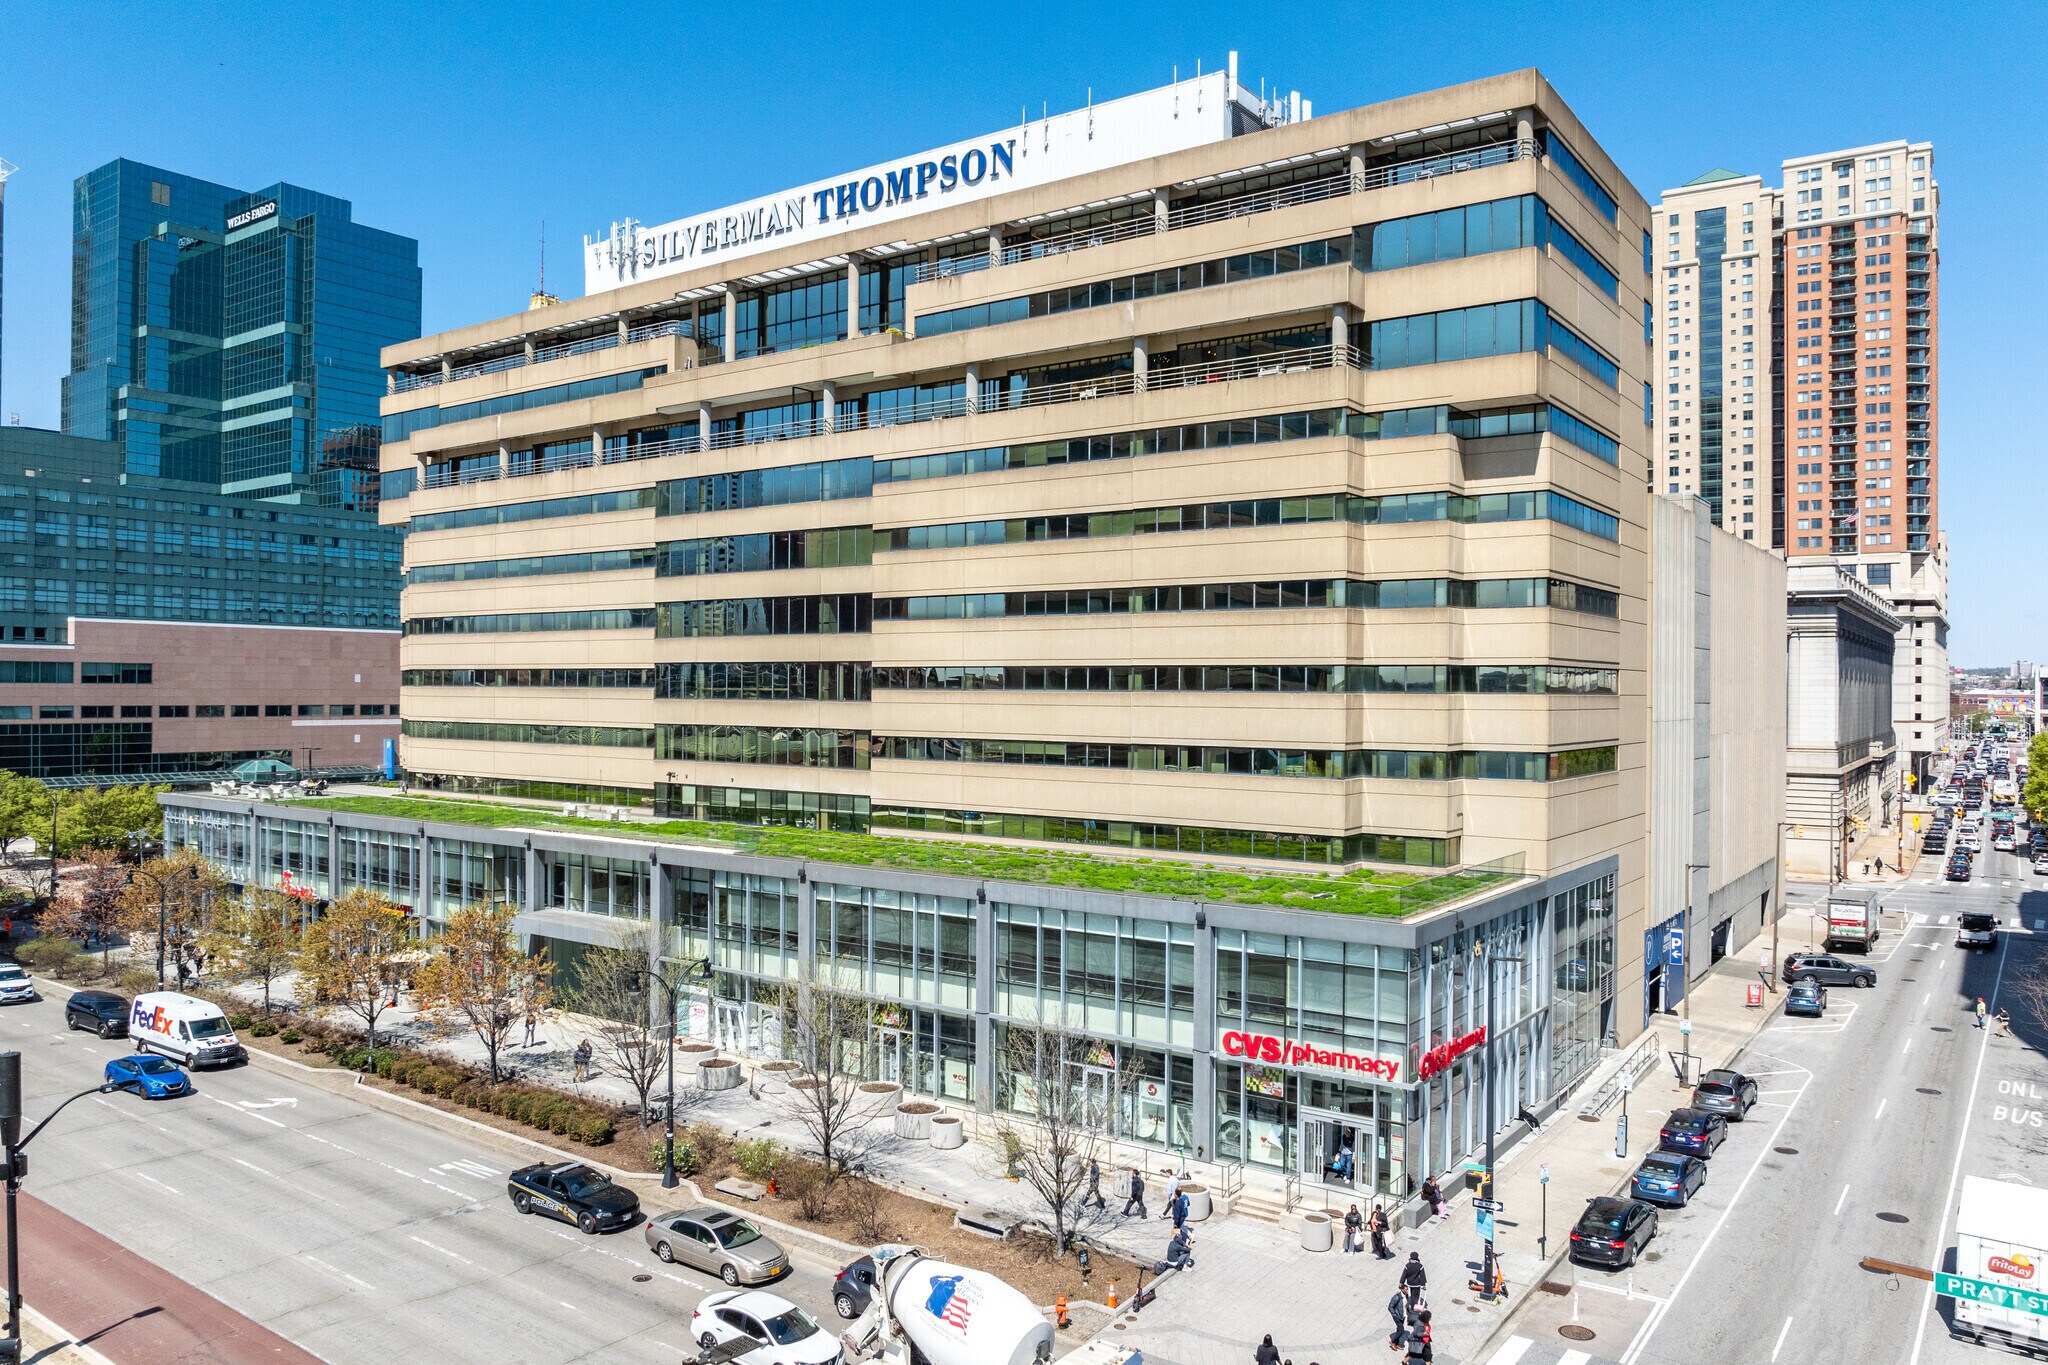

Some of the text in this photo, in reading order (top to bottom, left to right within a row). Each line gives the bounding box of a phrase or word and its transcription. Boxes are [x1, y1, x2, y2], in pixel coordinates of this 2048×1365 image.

[642, 139, 1017, 269] SILVERMAN THOMPSON
[227, 202, 275, 229] WELLS FARGO
[195, 814, 228, 831] TUCKER
[1671, 937, 1682, 950] P
[132, 1000, 173, 1036] FedEx
[206, 1037, 235, 1047] FedEx
[1222, 1030, 1399, 1082] CVS/pharmacy
[1330, 1105, 1341, 1113] 105
[1993, 1105, 2043, 1127] BUS
[530, 1196, 559, 1212] POLICE
[1947, 1278, 2048, 1312] PRATT ST
